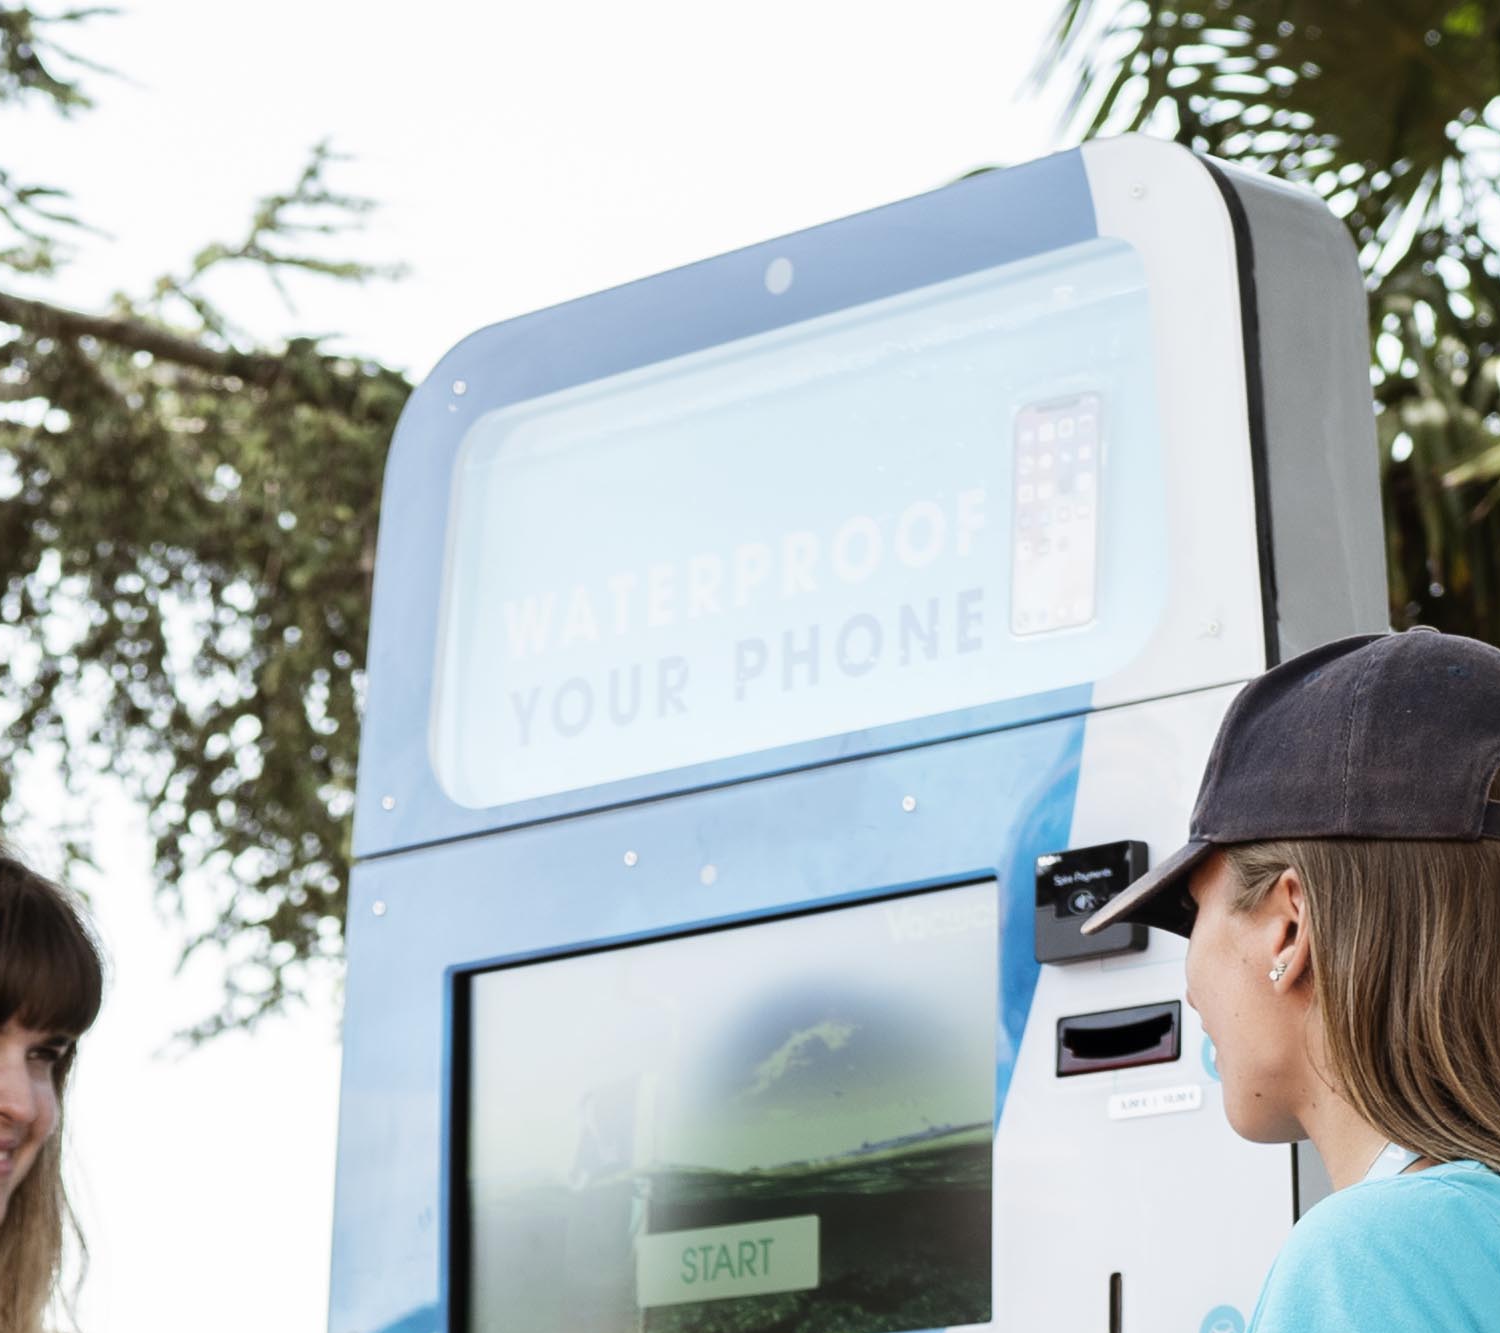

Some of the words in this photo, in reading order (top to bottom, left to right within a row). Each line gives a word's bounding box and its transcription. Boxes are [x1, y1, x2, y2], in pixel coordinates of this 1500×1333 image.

[503, 488, 986, 660] WATERPROOF
[508, 654, 689, 748] YOUR
[733, 587, 984, 702] PHONE
[681, 1237, 774, 1284] START
